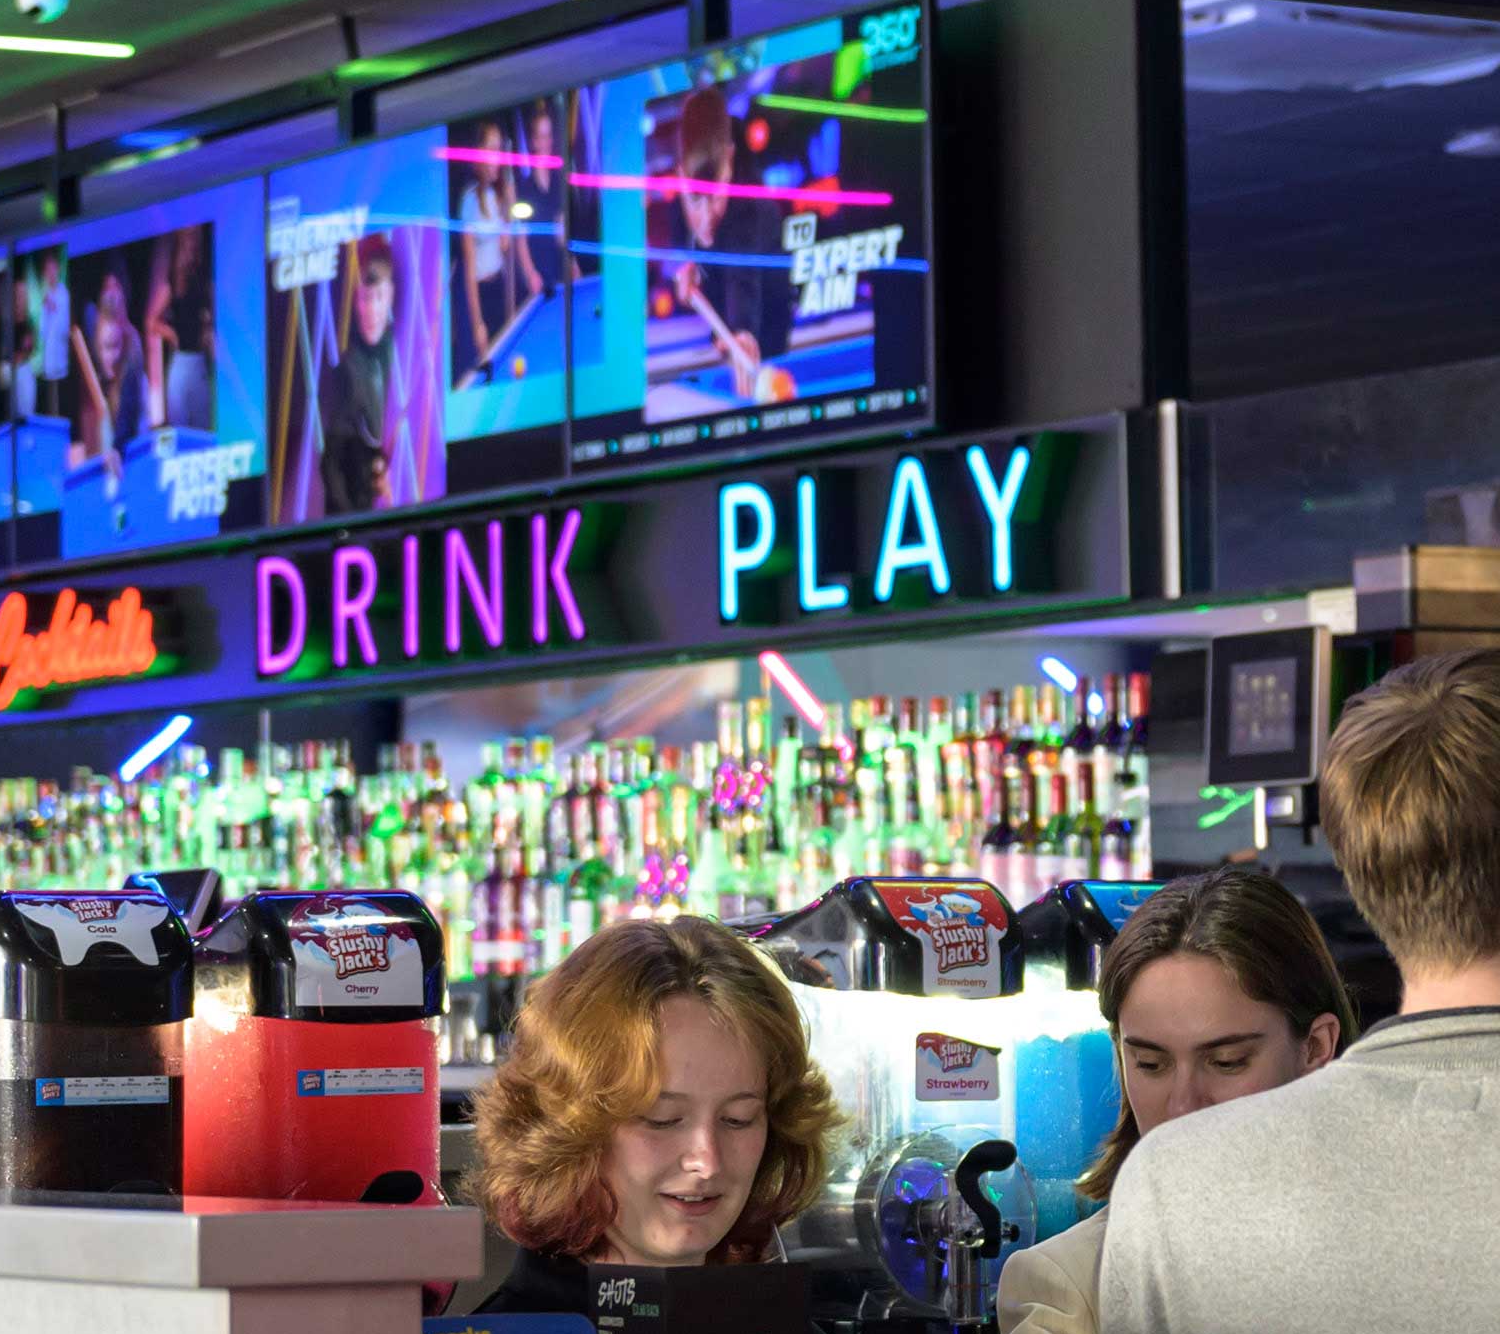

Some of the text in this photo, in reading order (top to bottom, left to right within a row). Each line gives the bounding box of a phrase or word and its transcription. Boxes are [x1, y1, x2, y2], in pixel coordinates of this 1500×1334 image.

[791, 224, 904, 286] EXPERT
[798, 270, 860, 318] AIM
[253, 508, 588, 676] DRINK
[715, 443, 1033, 624] PLAY
[78, 905, 114, 921] Jack's
[87, 924, 117, 934] Cola
[931, 925, 986, 948] Slushy
[327, 935, 386, 958] Slushy
[940, 942, 987, 968] Jack's
[337, 948, 388, 974] Jack's
[344, 984, 380, 995] Cherry
[937, 977, 988, 988] Strawberry
[940, 1042, 973, 1057] Slushy
[941, 1052, 972, 1069] Jack's
[926, 1078, 990, 1090] Strawberry
[597, 1278, 636, 1309] SHOTS
